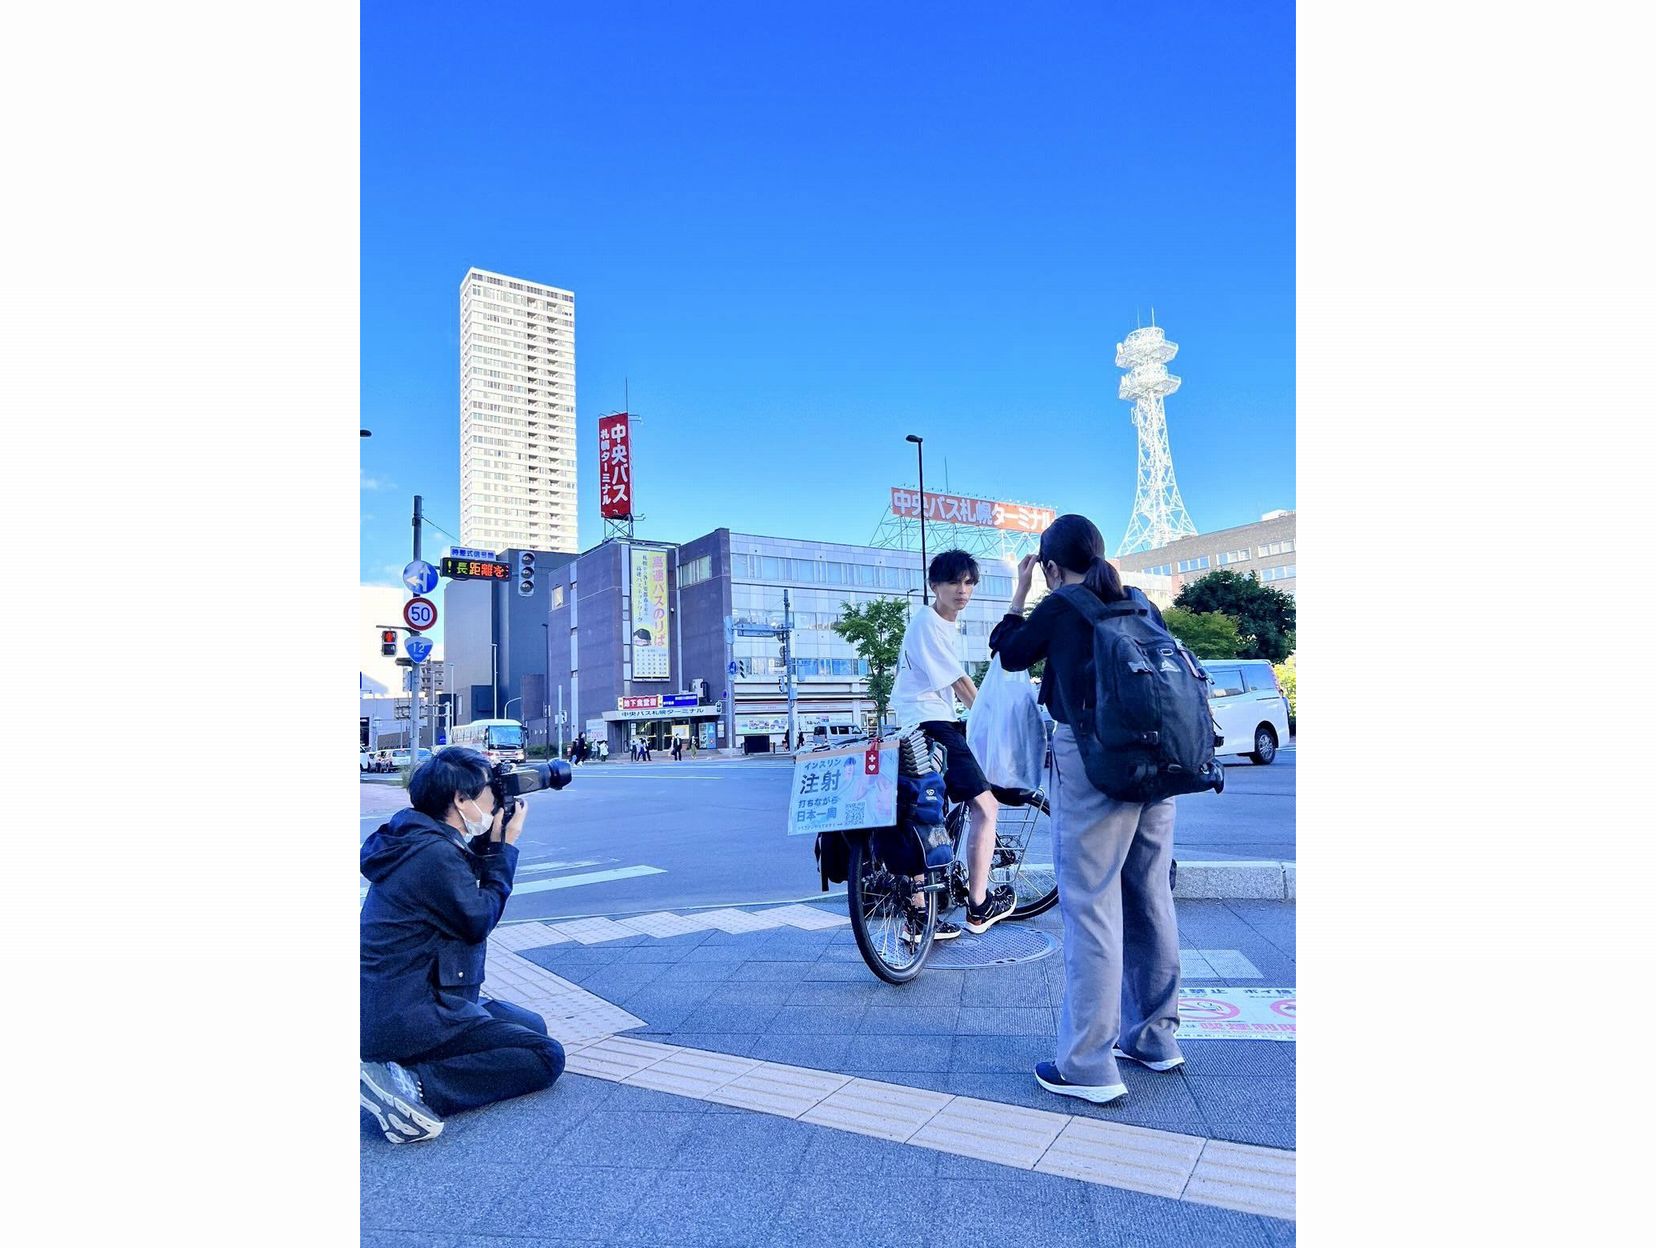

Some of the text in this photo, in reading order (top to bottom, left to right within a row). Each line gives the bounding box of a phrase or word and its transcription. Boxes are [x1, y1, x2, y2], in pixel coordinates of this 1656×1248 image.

[600, 428, 612, 505] 札幌ターミナル
[611, 423, 629, 504] 中央バス
[893, 490, 1052, 530] 中央バス札幌ターミナル
[411, 606, 431, 621] 50
[412, 643, 425, 654] 12
[804, 758, 841, 771] インスリン
[800, 769, 841, 795] 注射
[798, 796, 838, 809] 打ちながら
[797, 807, 837, 822] 日本一周
